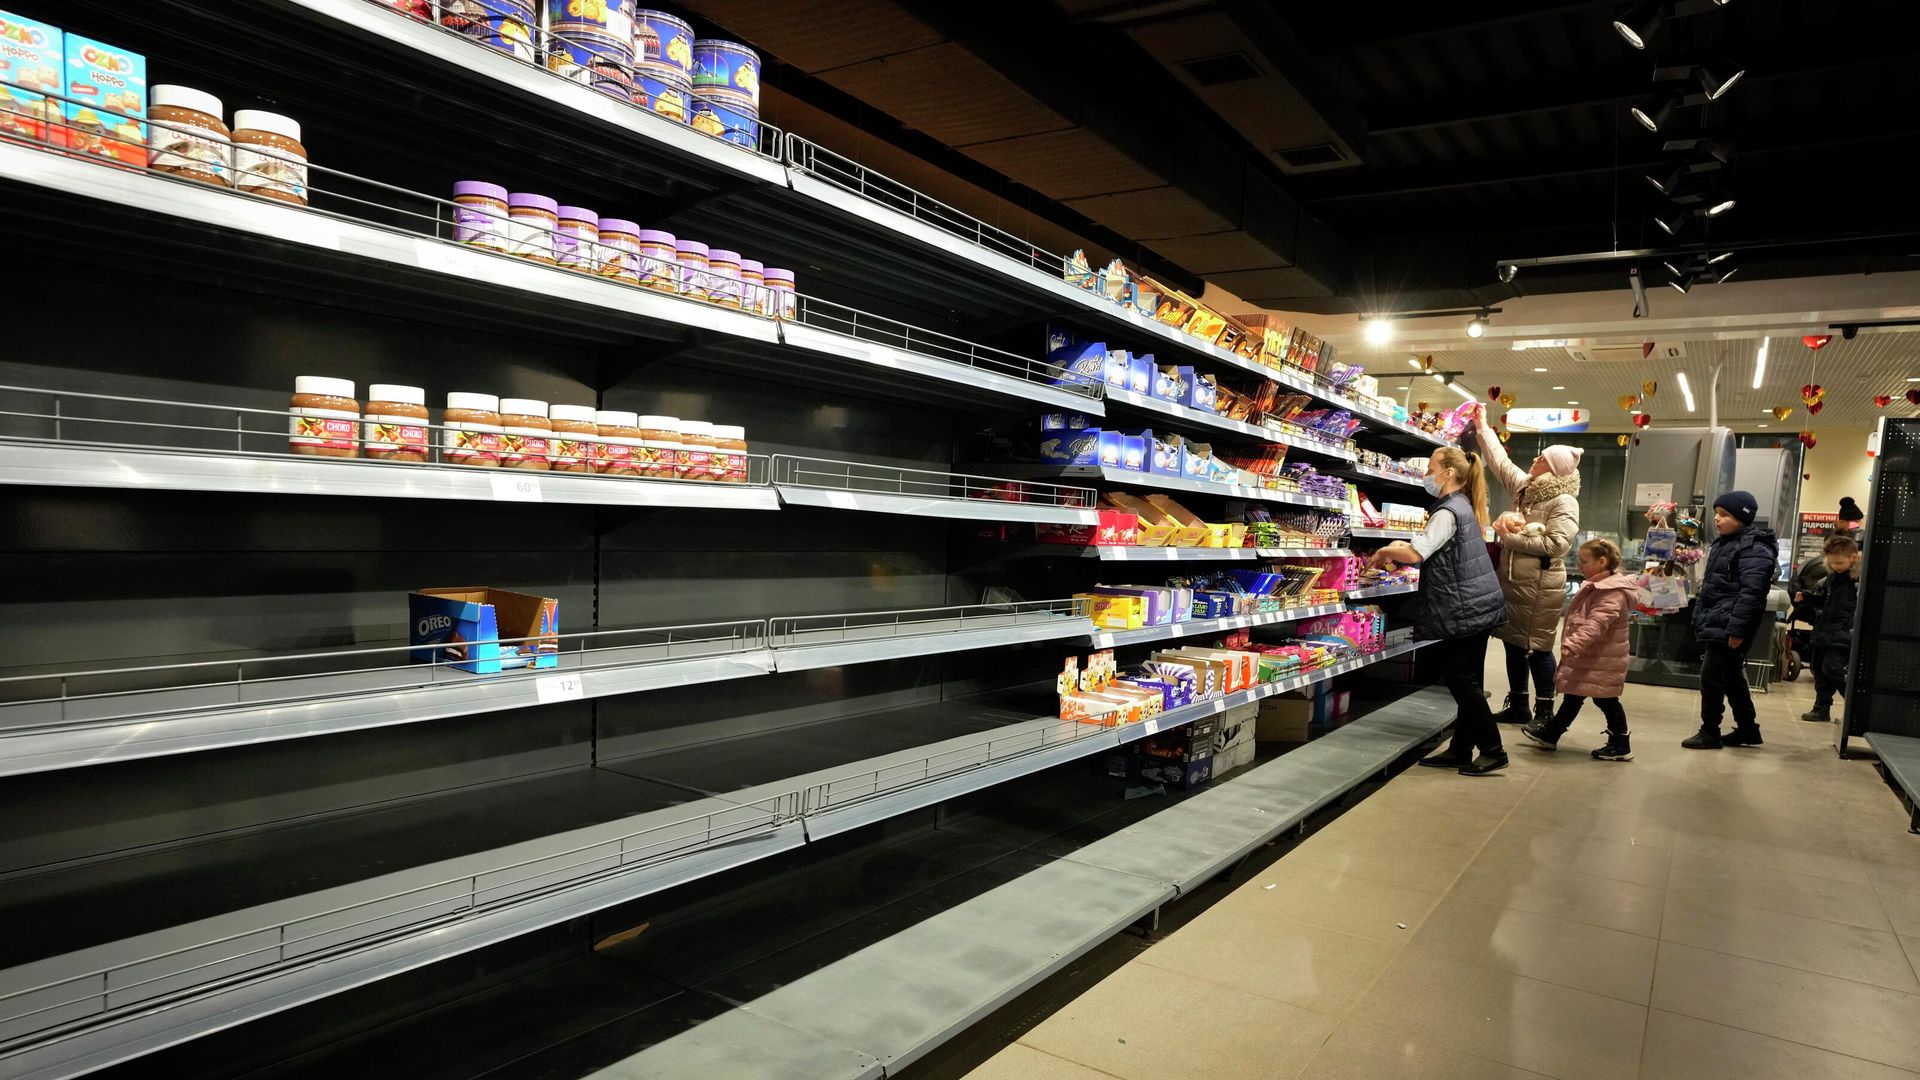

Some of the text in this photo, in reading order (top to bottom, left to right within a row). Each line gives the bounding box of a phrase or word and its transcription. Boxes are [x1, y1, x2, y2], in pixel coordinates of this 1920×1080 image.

[326, 422, 350, 433] CHOKO
[525, 439, 545, 448] CHOKO
[418, 615, 451, 637] OREO
